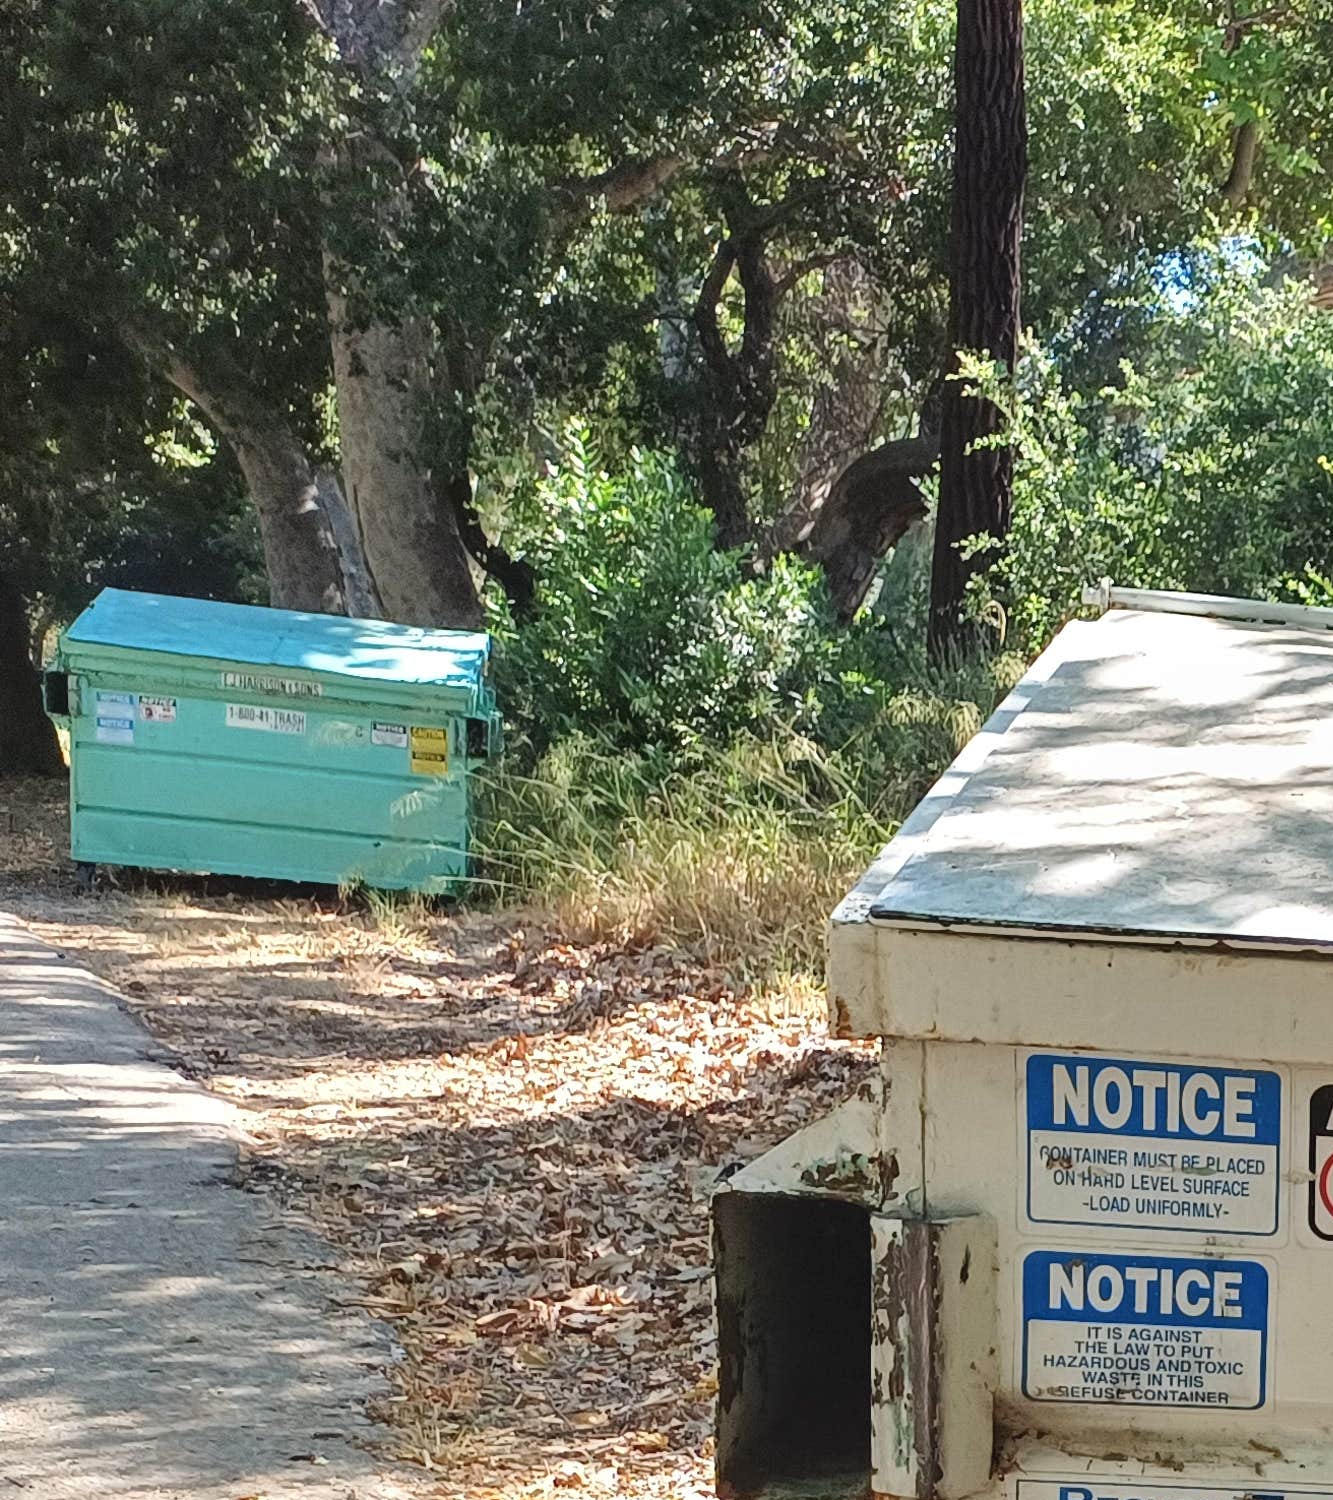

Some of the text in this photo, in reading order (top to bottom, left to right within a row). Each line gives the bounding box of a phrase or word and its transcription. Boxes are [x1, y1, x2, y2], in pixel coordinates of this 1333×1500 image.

[1053, 1064, 1255, 1137] NOTICE
[1134, 1151, 1177, 1169] MUST
[1182, 1155, 1200, 1169] BE
[1207, 1157, 1265, 1175] PLACED
[1054, 1170, 1249, 1196] ON HARD LEVEL SURFACE
[1083, 1196, 1229, 1218] -LOAD UNIFORMLY-
[1049, 1263, 1242, 1317] NOTICE
[1087, 1326, 1202, 1342] IT IS AGAINST
[1075, 1341, 1213, 1358] THE LAW TO PUT
[1044, 1355, 1243, 1374] HAZARDOUS AND TOXIC
[1082, 1372, 1203, 1387] WASTE IN THIS
[1132, 1389, 1228, 1404] CONTAINER
